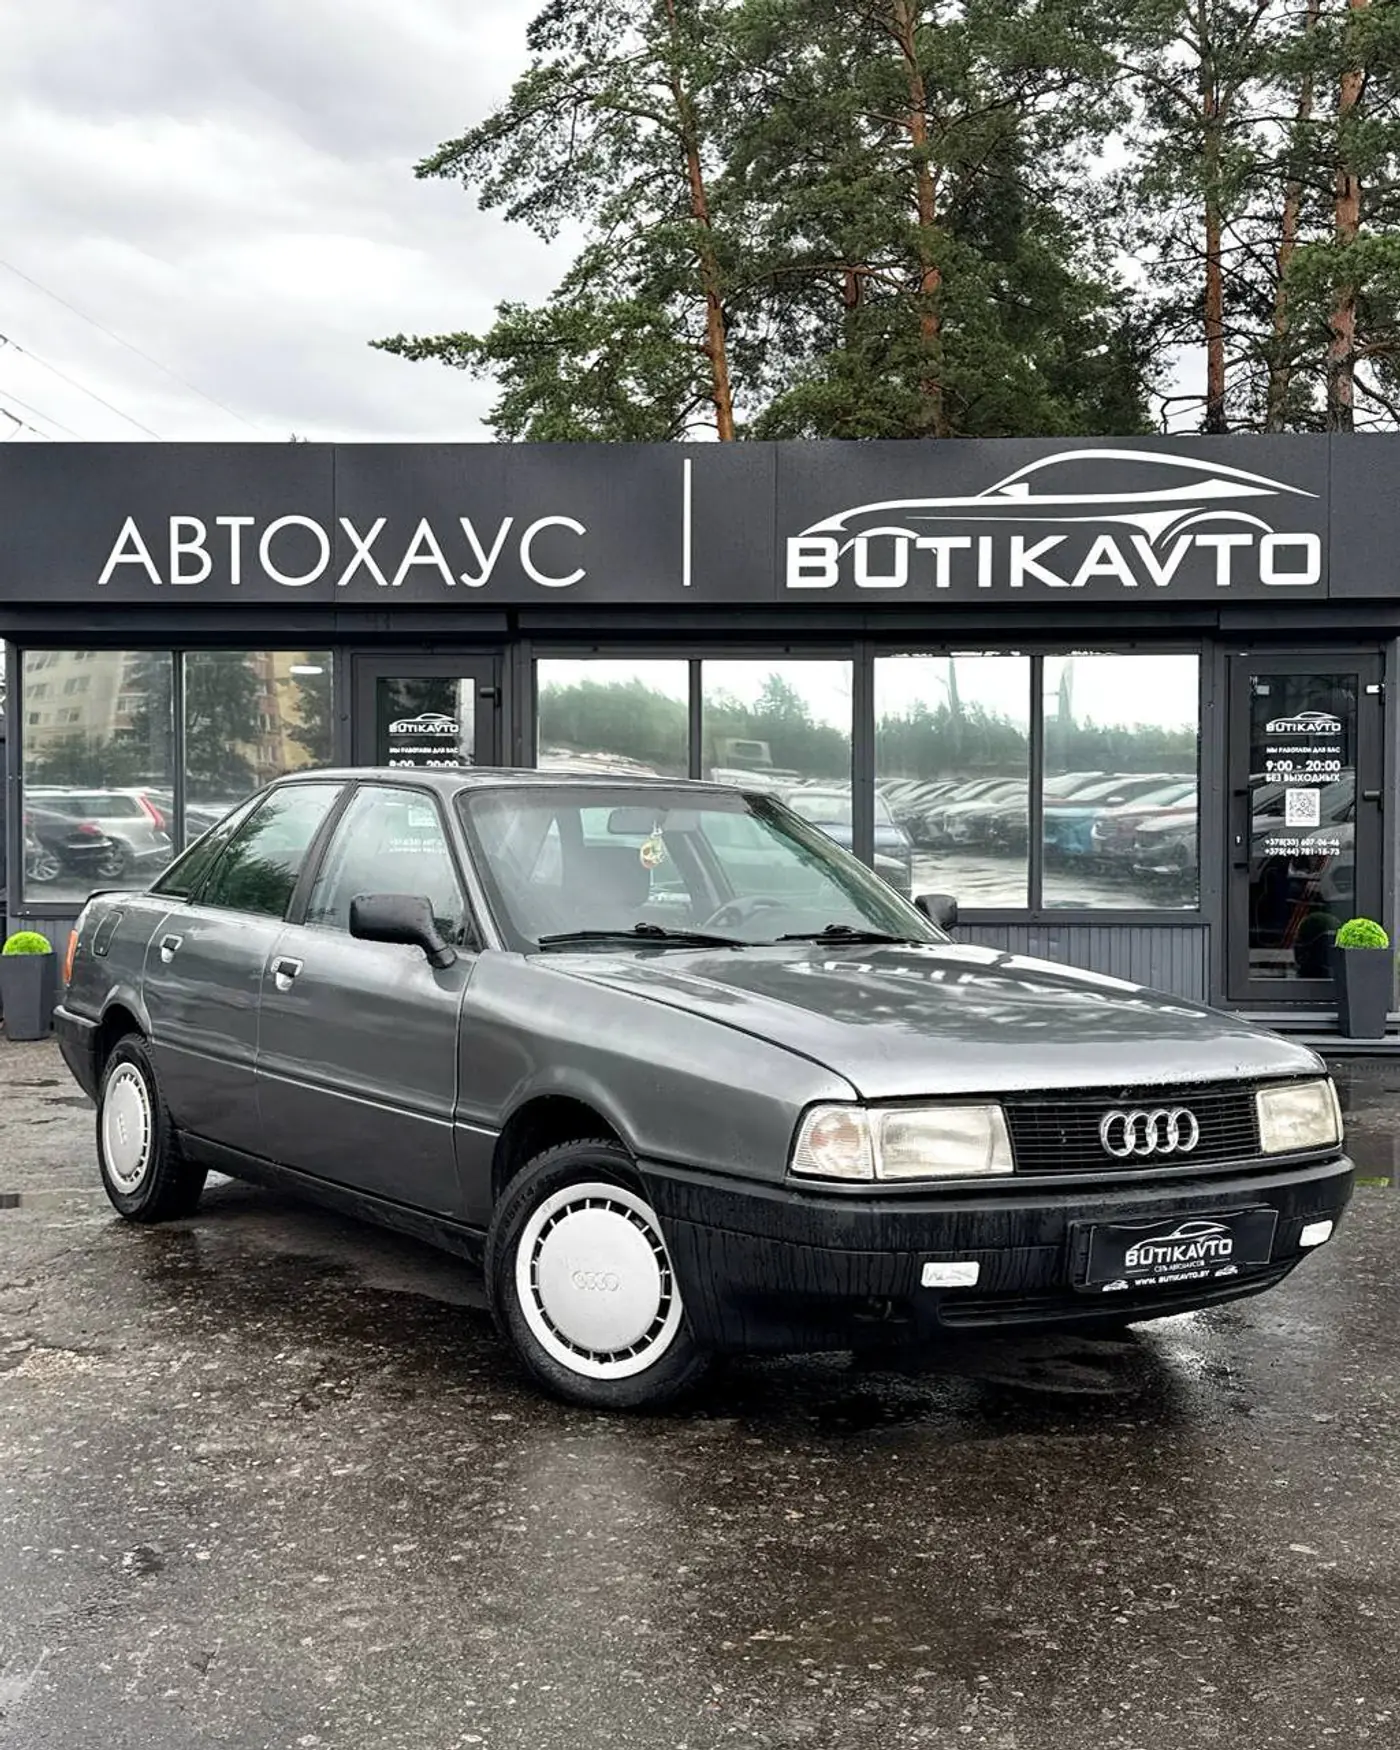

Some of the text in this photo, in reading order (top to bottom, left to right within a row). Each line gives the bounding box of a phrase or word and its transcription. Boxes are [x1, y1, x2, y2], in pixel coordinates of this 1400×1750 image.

[98, 515, 587, 588] АВТОХАУС
[786, 532, 1321, 588] BUTIKAVTO
[389, 724, 459, 733] BUTIKAVTO
[1265, 723, 1341, 732] BUTIKAVTO
[1265, 760, 1293, 772] 9:00
[1305, 760, 1341, 772] 20:00
[1265, 773, 1340, 783] БЕЗ ВЫХОДНЫХ
[1125, 1239, 1233, 1267] BUTIKAVTO
